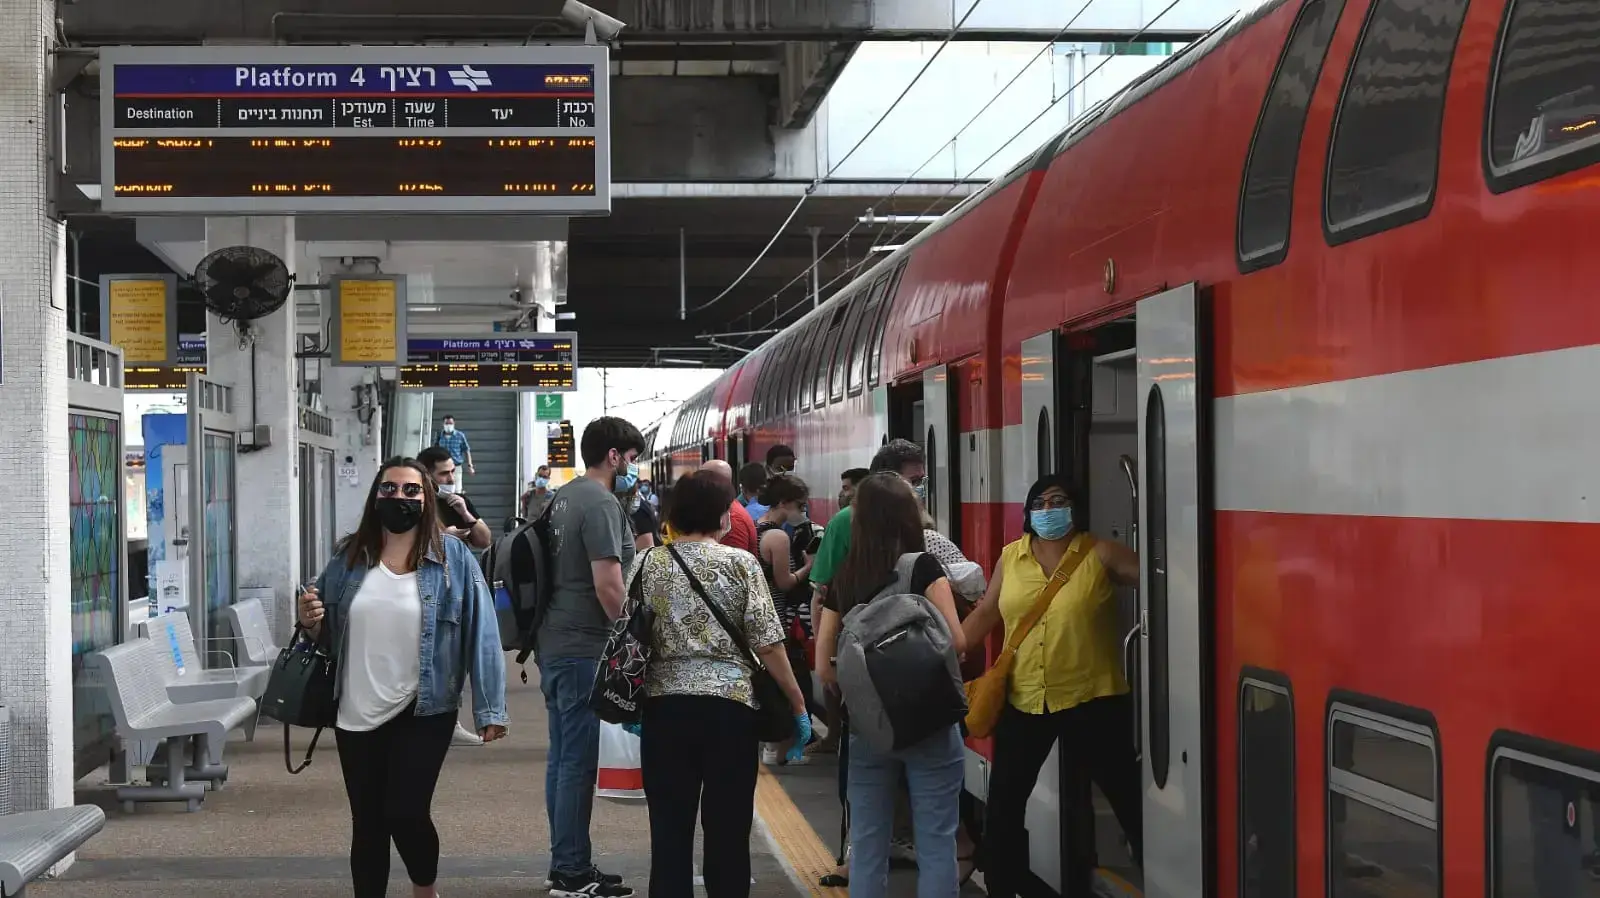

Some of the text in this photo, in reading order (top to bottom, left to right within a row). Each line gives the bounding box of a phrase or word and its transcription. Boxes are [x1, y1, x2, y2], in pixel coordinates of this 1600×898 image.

[236, 67, 436, 92] Platform 4 רציף
[127, 107, 194, 120] Destination
[238, 108, 323, 120] תחנות ביניים
[341, 102, 387, 116] מעודכן
[404, 102, 435, 114] שעה
[491, 108, 513, 120] יעד
[563, 102, 594, 114] רכבת
[406, 116, 435, 127] Time
[443, 340, 516, 350] Platform 4 רציף
[603, 688, 636, 712] MOSES
